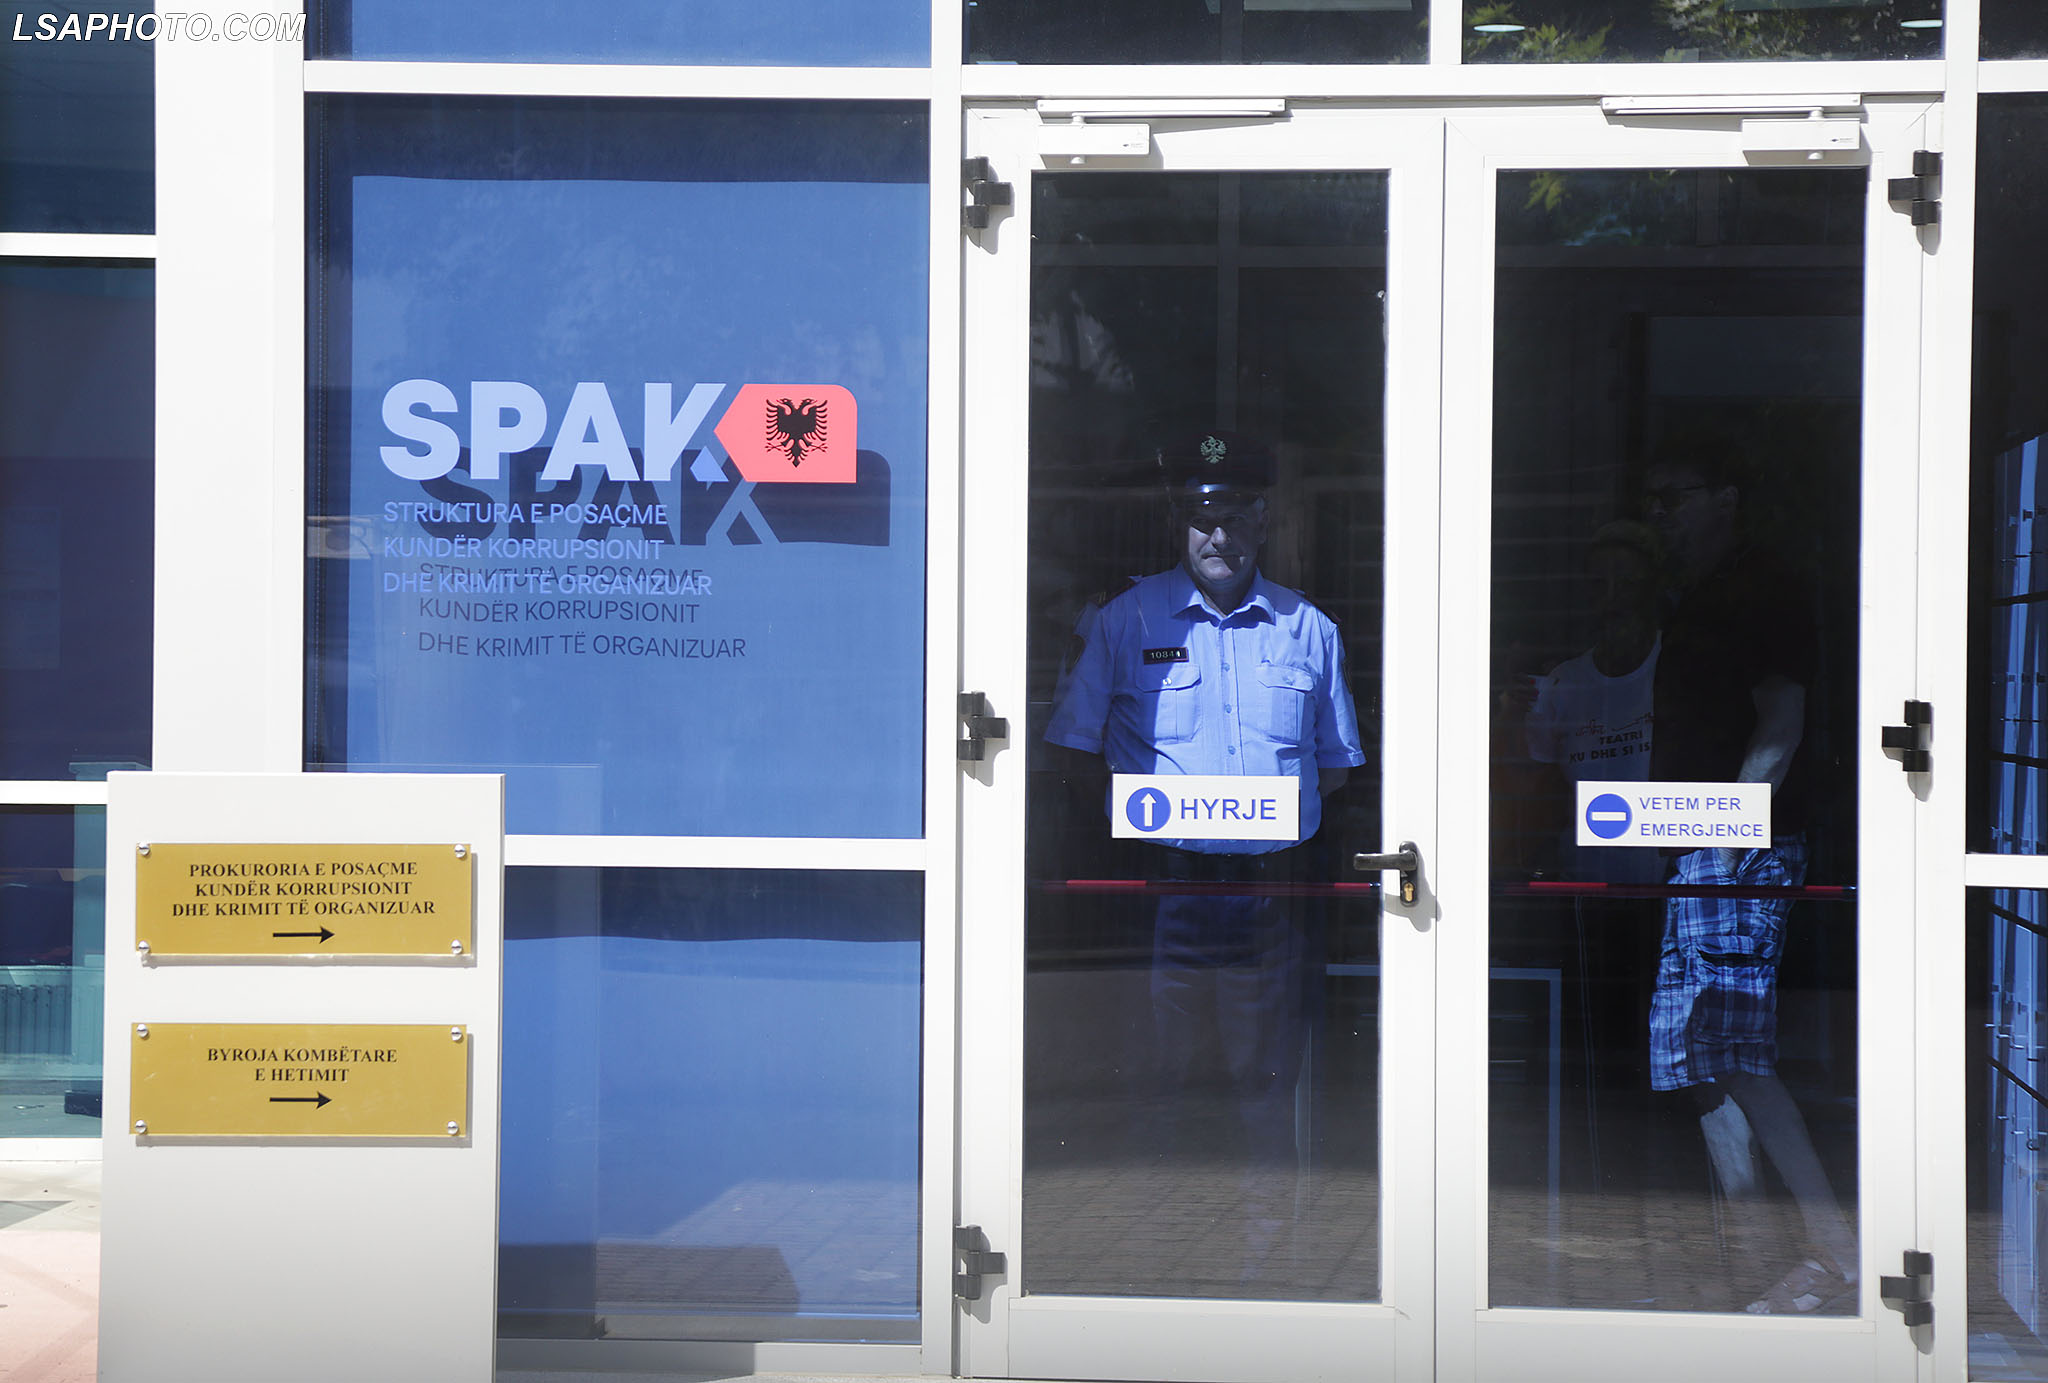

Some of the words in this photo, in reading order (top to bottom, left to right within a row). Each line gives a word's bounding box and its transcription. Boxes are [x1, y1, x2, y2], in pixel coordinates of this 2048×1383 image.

[380, 378, 728, 481] SPAK
[383, 502, 525, 523] STRUKTURA
[531, 503, 544, 523] E
[550, 503, 667, 528] POSAÇME
[384, 534, 482, 559] KUNDËR
[488, 538, 665, 560] KORRUPSIONIT
[383, 572, 433, 593] DHE
[439, 573, 519, 593] KRIMIT
[524, 570, 552, 594] TË
[558, 573, 713, 596] ORGANIZUAR
[419, 598, 518, 623] KUNDËR
[525, 600, 700, 623] KORRUPSIONIT
[418, 632, 469, 656] DHE
[475, 634, 554, 658] KRIMIT
[560, 631, 586, 654] TË
[593, 634, 747, 659] ORGANIZUAR
[1599, 730, 1643, 745] TEATRI
[1591, 748, 1617, 760] DHE
[1180, 798, 1277, 820] HYRJE
[1639, 797, 1700, 810] VETEM
[1706, 797, 1742, 810] PER
[1641, 823, 1764, 837] EMERGJENCE
[189, 863, 309, 877] PROKURORIA
[315, 863, 325, 877] E
[332, 861, 418, 880] POSAÇME
[195, 880, 270, 897] KUNDËR
[276, 881, 413, 896] KORRUPSIONIT
[172, 903, 210, 917] DHE
[215, 903, 282, 916] KRIMIT
[286, 898, 309, 915] TË
[314, 901, 436, 916] ORGANIZUAR
[207, 1048, 278, 1062] BYROJA
[283, 1045, 398, 1063] KOMBËTARE
[255, 1068, 266, 1082] E
[271, 1068, 350, 1082] HETIMIT
